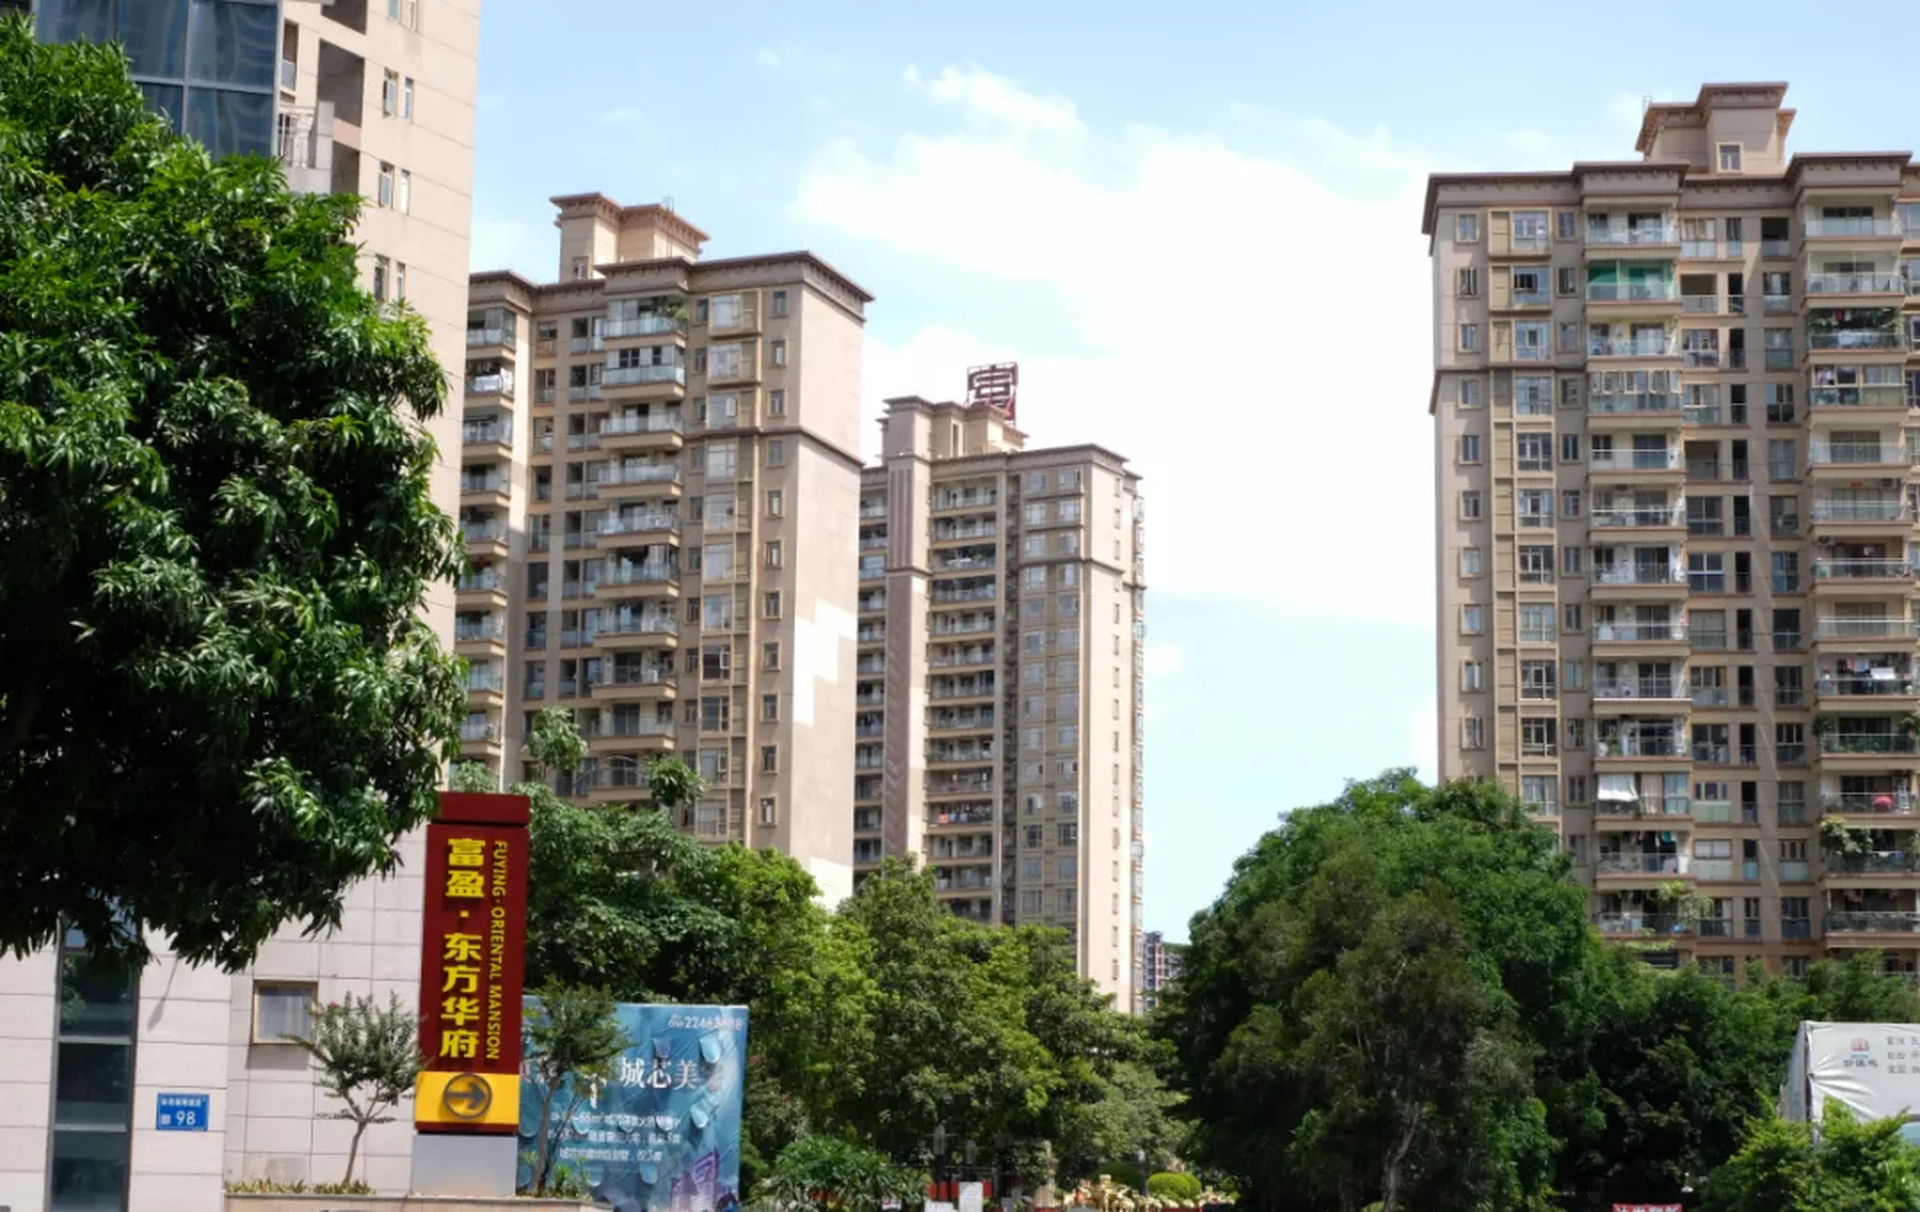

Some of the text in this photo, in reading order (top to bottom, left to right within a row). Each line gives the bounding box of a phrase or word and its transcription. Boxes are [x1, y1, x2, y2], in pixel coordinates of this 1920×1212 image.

[486, 841, 508, 1060] FUYING ORIENTAL MANSION
[176, 1110, 196, 1126] 98
